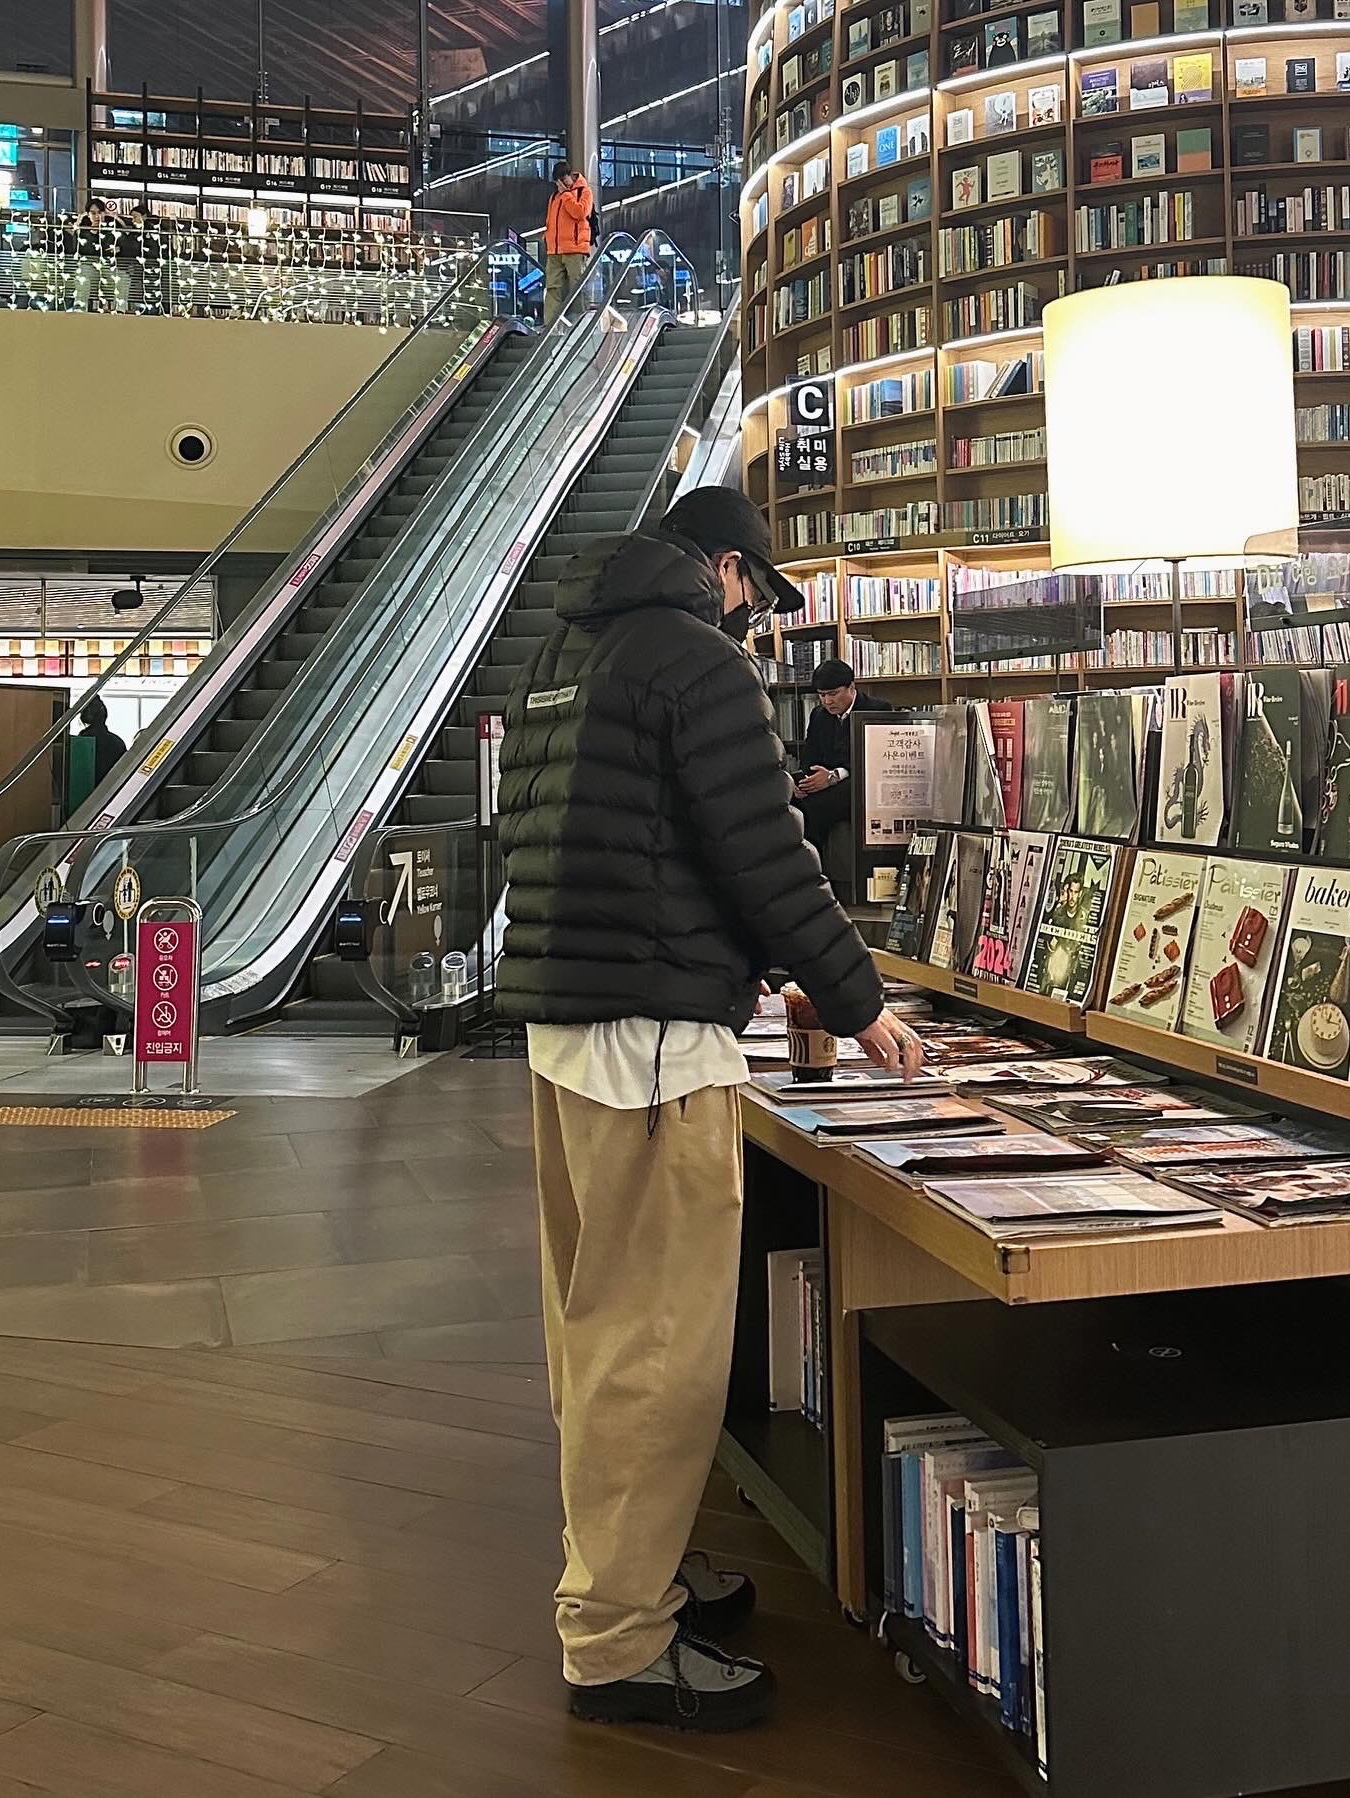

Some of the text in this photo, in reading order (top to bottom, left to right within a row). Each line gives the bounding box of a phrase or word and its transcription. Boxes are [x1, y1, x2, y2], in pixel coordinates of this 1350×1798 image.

[798, 385, 824, 420] C
[797, 438, 827, 454] 취미
[797, 455, 828, 472] 실용
[973, 533, 989, 544] C11
[847, 542, 861, 552] C10
[887, 739, 921, 750] 고객감사
[883, 750, 925, 760] 사은이벤트
[974, 935, 1012, 975] 2024
[145, 1042, 182, 1055] 진입금지
